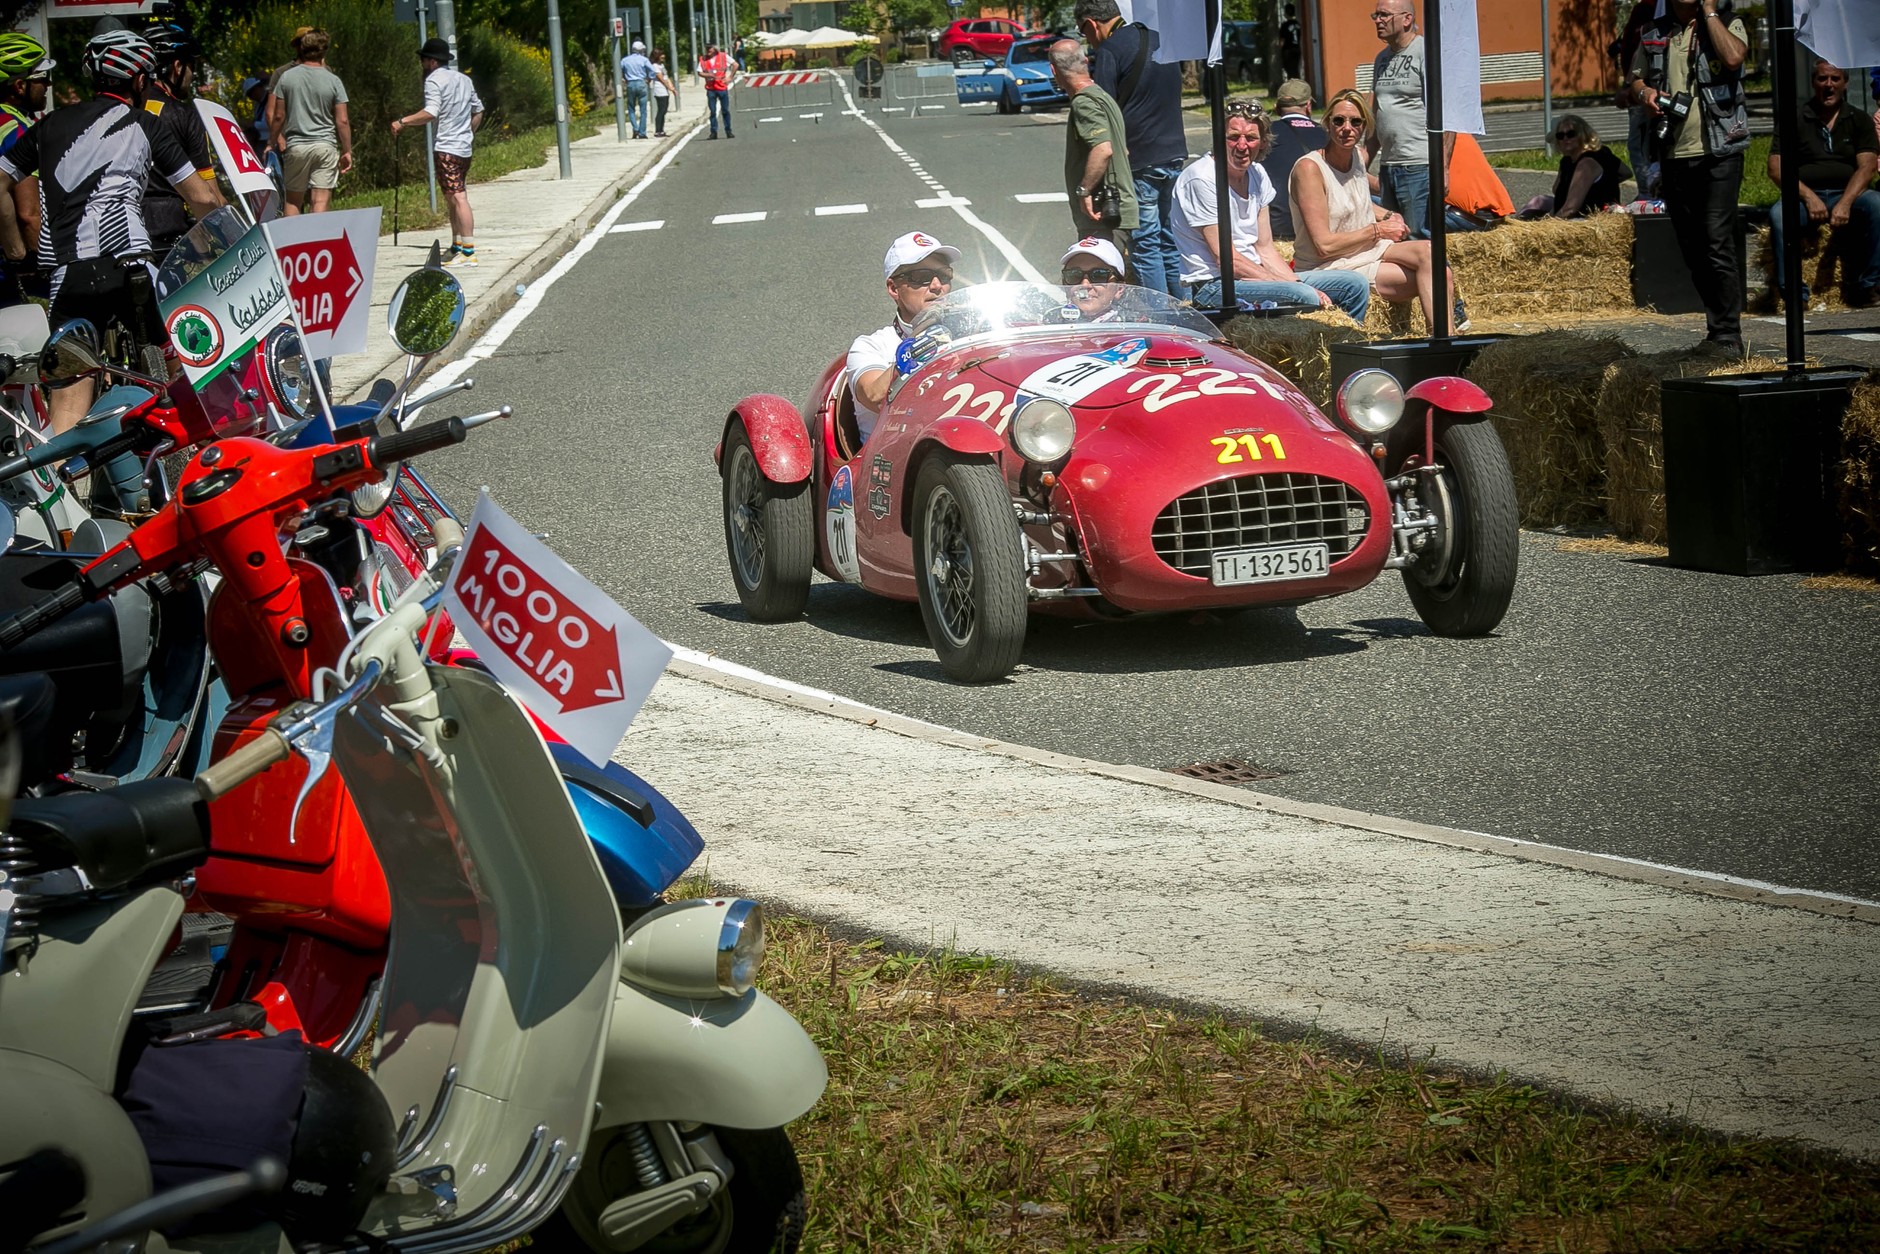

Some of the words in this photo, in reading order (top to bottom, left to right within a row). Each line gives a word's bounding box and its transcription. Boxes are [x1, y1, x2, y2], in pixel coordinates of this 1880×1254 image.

[237, 241, 267, 272] Club
[1046, 362, 1110, 387] 211
[1126, 368, 1285, 413] 221
[1210, 433, 1287, 464] 211
[833, 517, 850, 564] 211
[484, 549, 589, 649] 1000
[460, 575, 574, 695] MIGLIA
